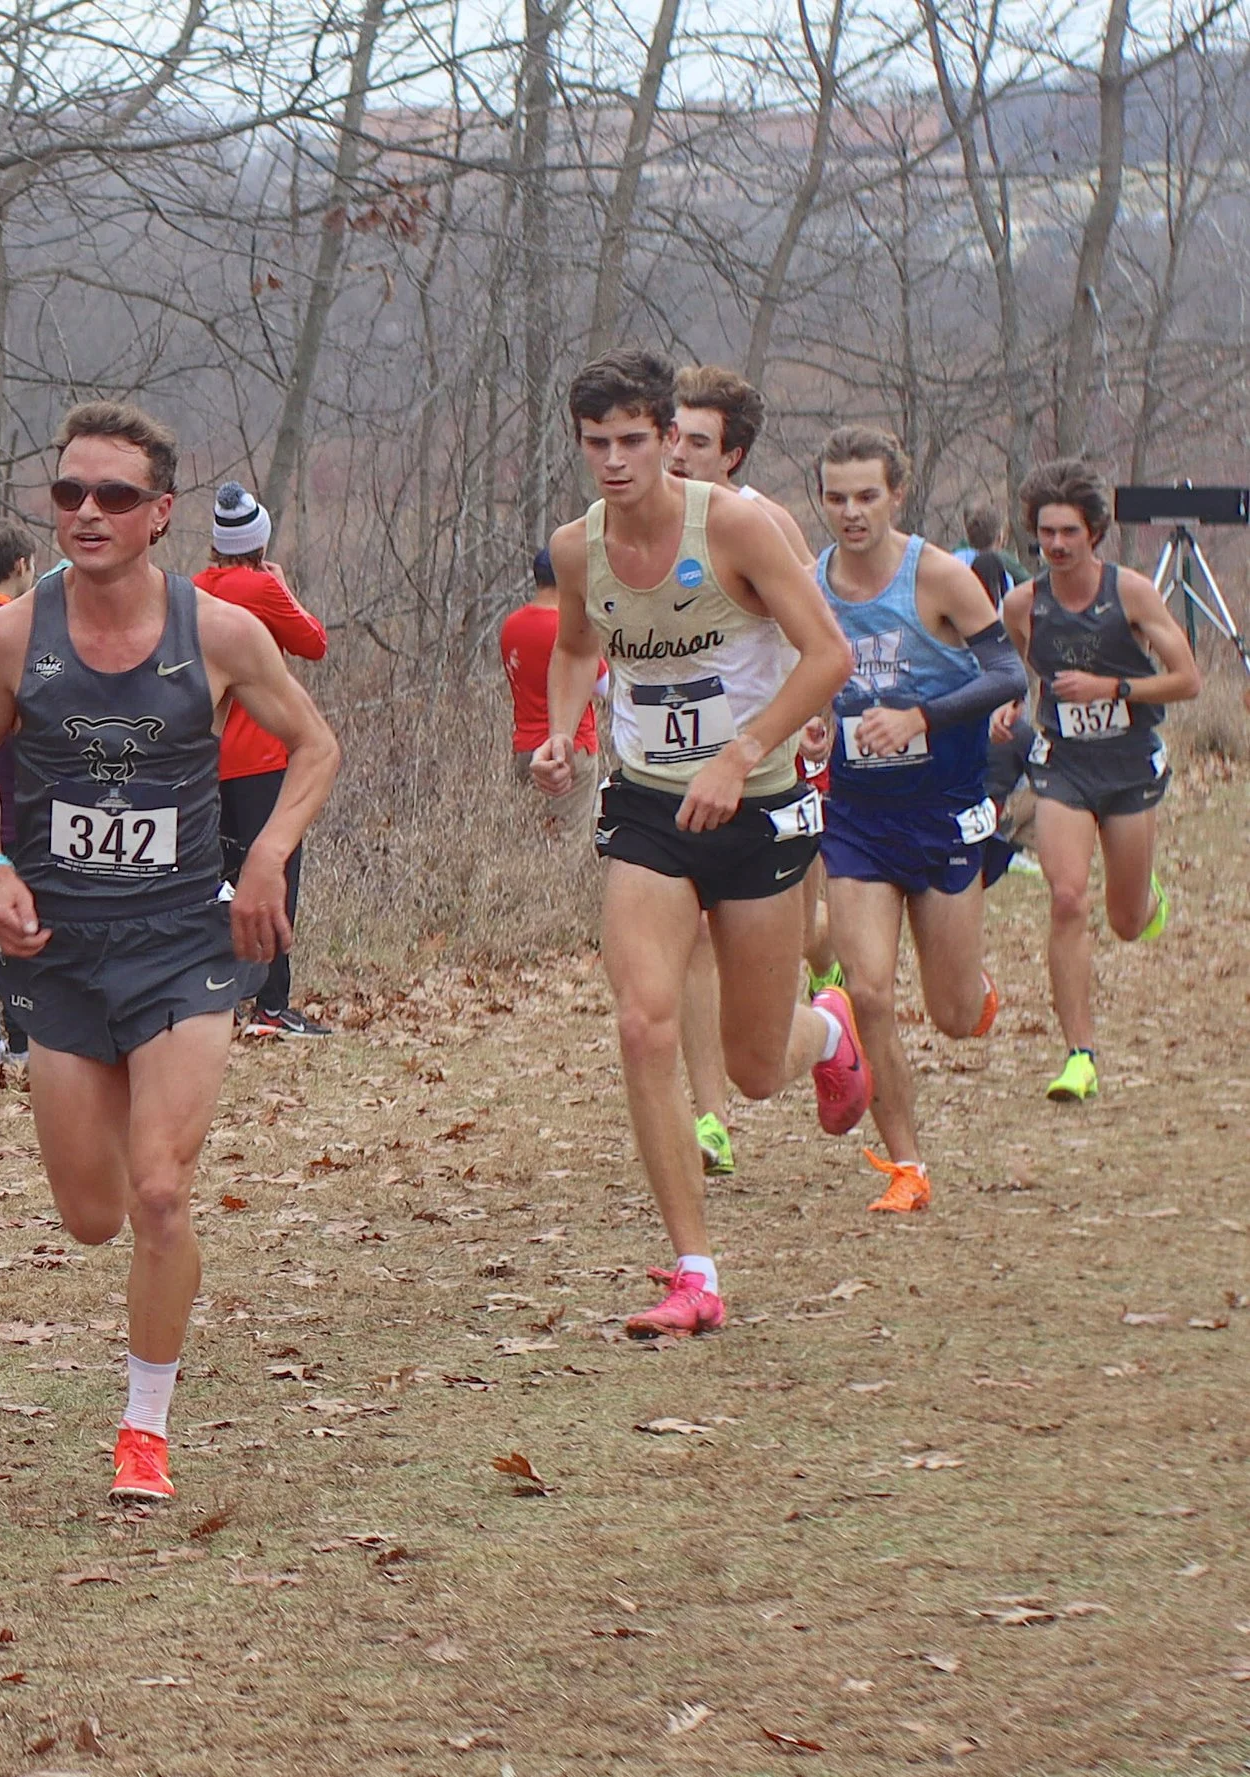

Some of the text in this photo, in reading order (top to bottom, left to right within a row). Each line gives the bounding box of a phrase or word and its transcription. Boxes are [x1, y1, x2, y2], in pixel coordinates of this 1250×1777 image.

[608, 628, 725, 660] Anderson
[35, 662, 63, 672] RMAC
[665, 708, 699, 749] 47
[1070, 702, 1115, 736] 352
[797, 797, 819, 835] 47
[70, 814, 156, 864] 342
